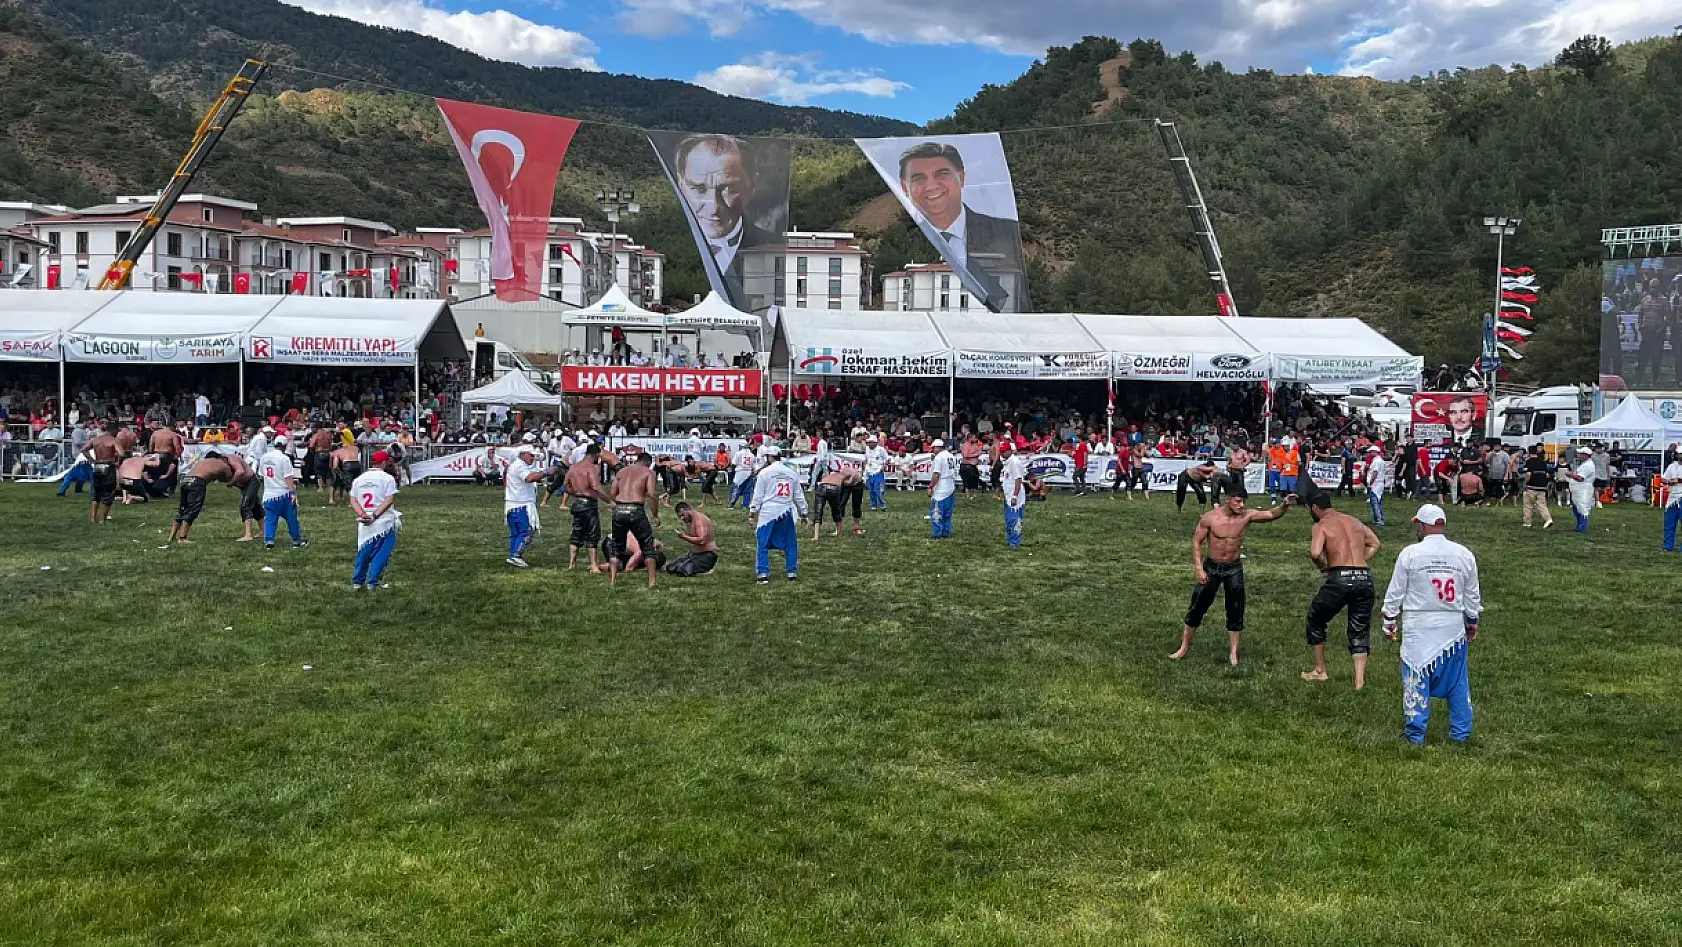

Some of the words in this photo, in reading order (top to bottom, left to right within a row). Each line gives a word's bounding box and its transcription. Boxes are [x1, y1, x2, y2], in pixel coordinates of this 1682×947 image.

[2, 340, 53, 352] ŞAFAK
[84, 340, 140, 355] LAGOON
[179, 337, 235, 347] SARIKAYA
[364, 338, 396, 351] YAPI
[188, 349, 225, 357] TARIM
[841, 355, 897, 365] lokman
[902, 356, 947, 366] hekim
[1133, 354, 1190, 368] ÖZMEĞRİ
[1218, 356, 1244, 368] Ford
[840, 365, 880, 374] ESNAF
[1196, 368, 1264, 379] HELVACIOĞLU
[578, 372, 660, 390] HAKEM
[647, 443, 664, 452] TÜM
[777, 482, 791, 497] 23
[362, 493, 374, 508] 2
